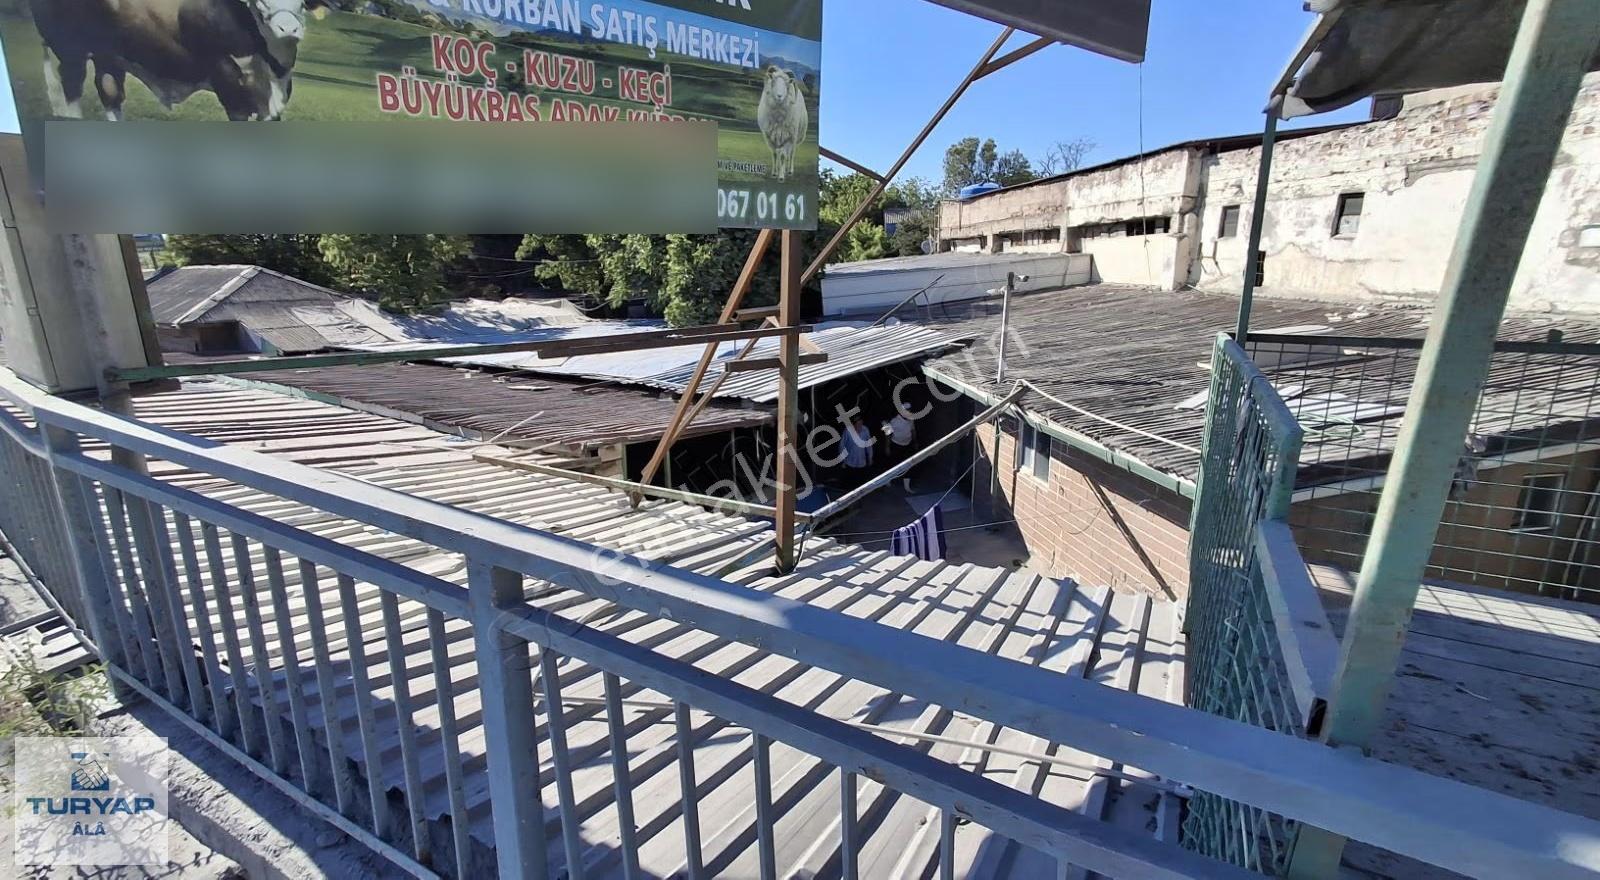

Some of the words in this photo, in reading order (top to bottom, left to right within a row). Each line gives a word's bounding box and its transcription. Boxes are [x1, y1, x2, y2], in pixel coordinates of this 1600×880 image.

[591, 4, 658, 59] SATIŞ
[666, 21, 760, 69] MERKEZİ
[433, 34, 497, 89] KOÇ
[524, 50, 595, 95] KUZU
[619, 65, 672, 112] KEÇİ
[718, 189, 749, 218] 067
[757, 192, 777, 219] 01
[785, 194, 804, 220] 61
